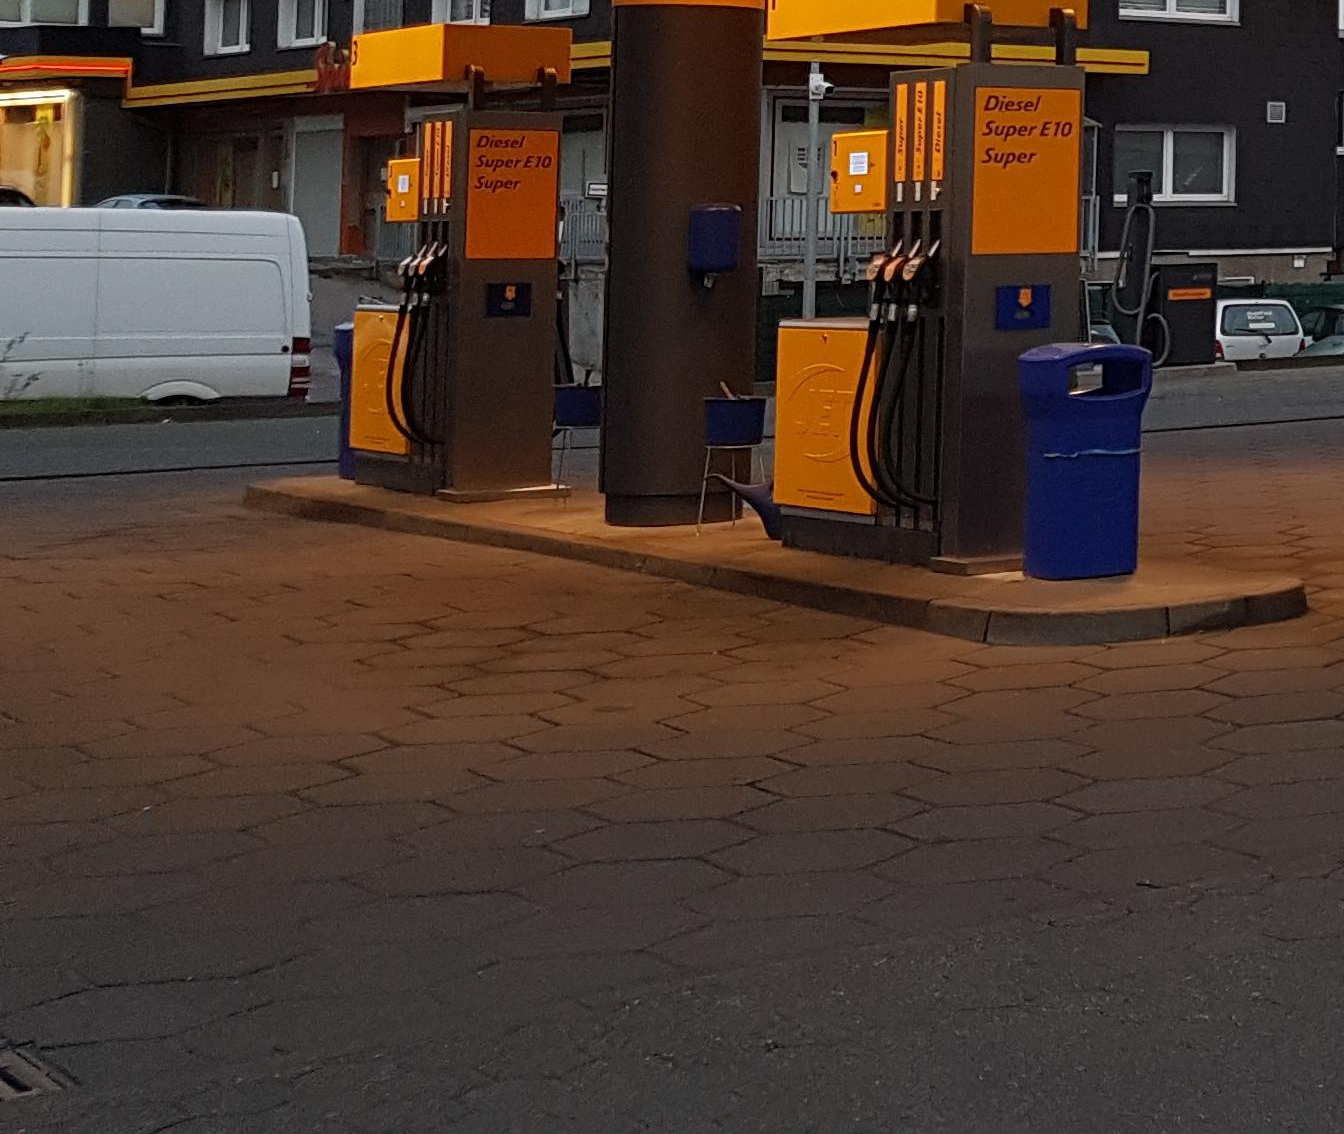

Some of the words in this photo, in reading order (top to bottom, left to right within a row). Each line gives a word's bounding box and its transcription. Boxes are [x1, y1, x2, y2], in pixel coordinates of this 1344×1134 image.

[983, 95, 1041, 113] Diesel
[982, 120, 1037, 141] Super
[1039, 120, 1073, 137] E10
[476, 135, 526, 149] Diesel
[475, 154, 522, 172] Super
[522, 155, 553, 169] E10
[981, 147, 1037, 170] Super
[474, 176, 521, 194] Super
